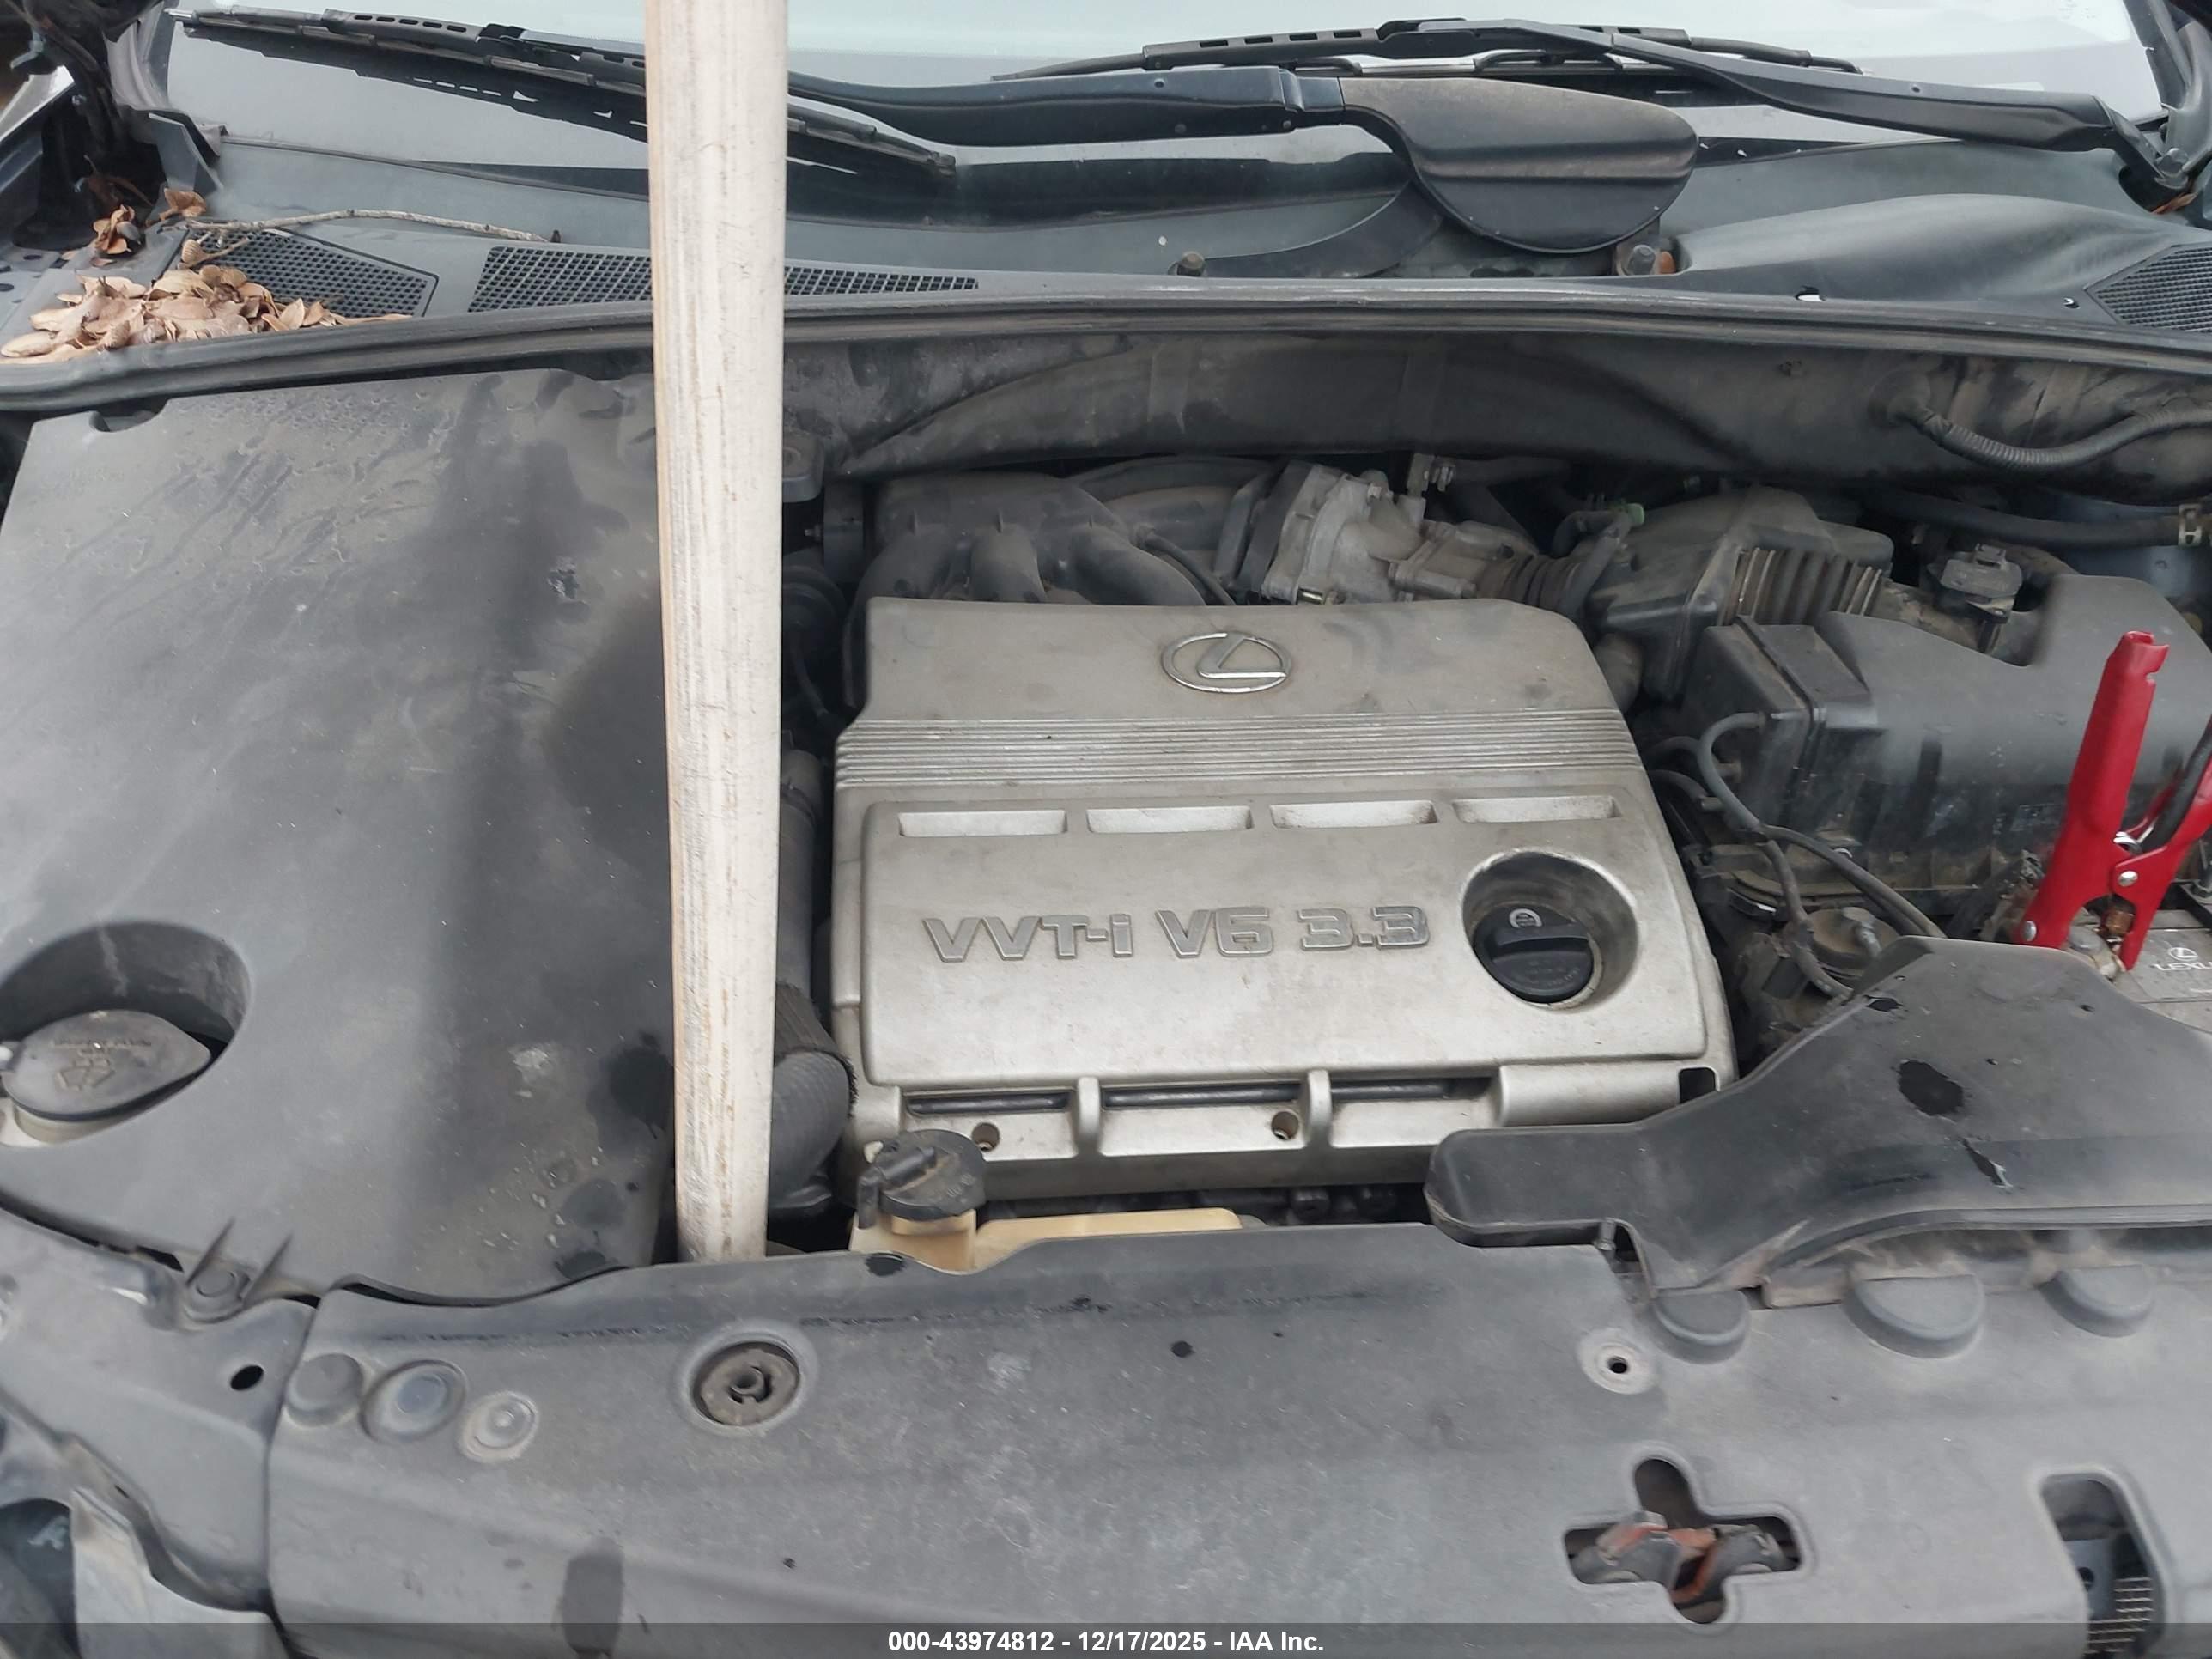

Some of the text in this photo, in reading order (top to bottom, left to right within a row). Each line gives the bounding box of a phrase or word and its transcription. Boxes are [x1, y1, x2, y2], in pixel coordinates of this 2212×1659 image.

[922, 906, 1431, 962] VVT-i V6 3.3
